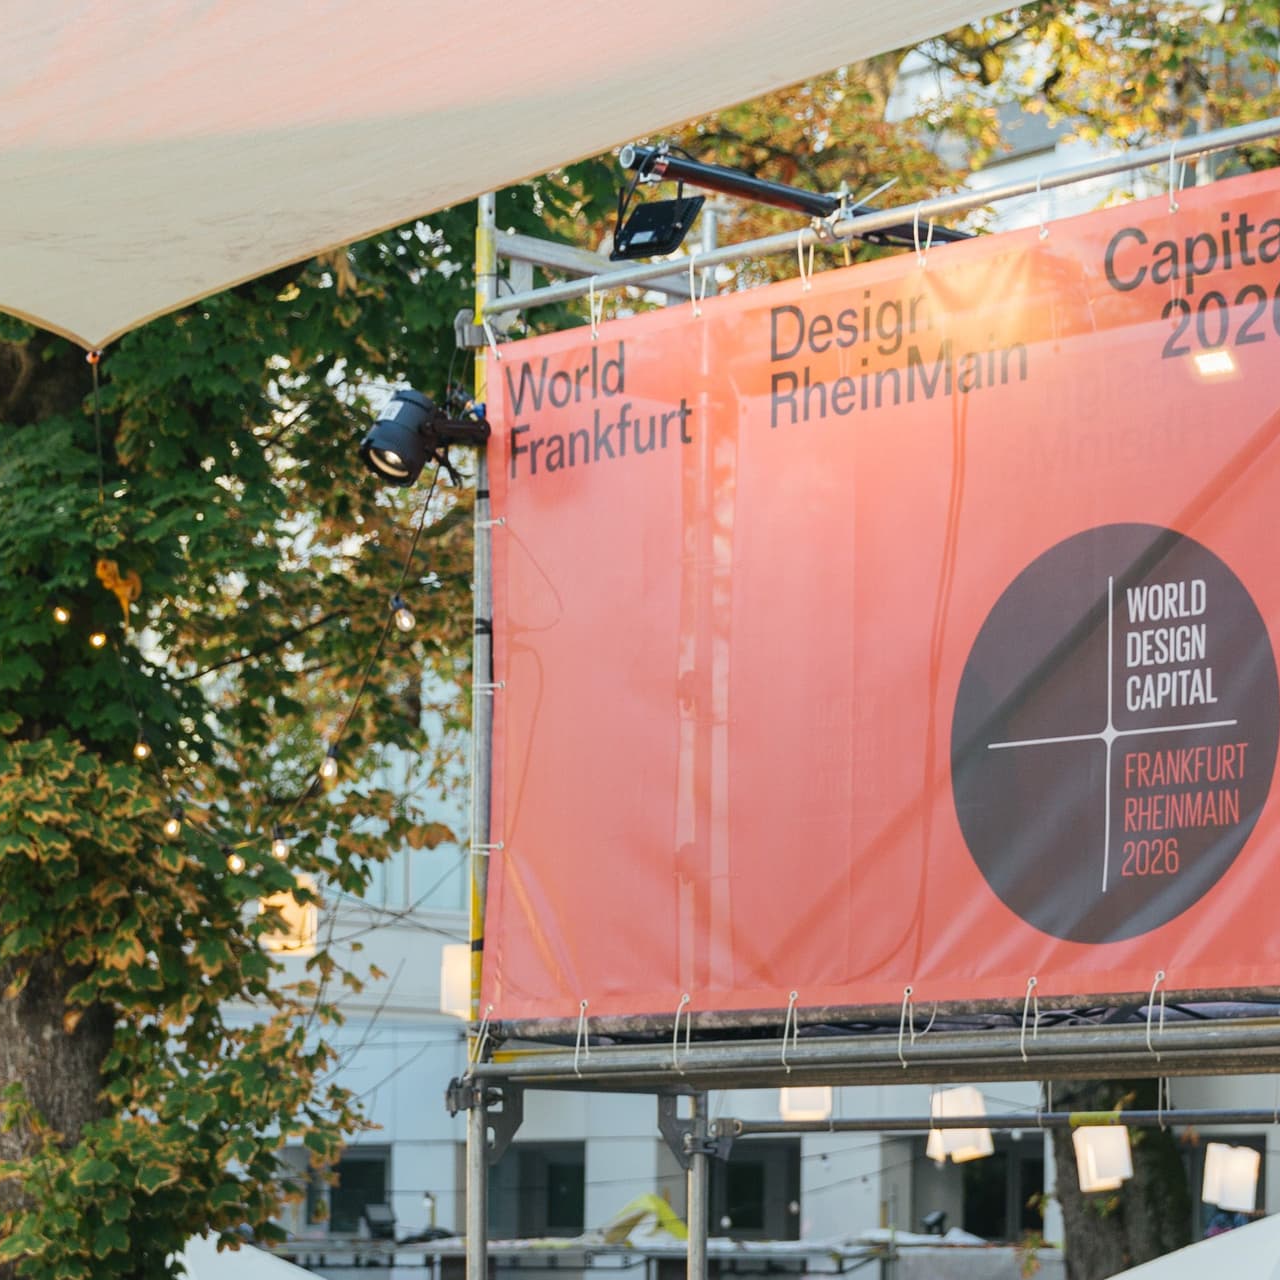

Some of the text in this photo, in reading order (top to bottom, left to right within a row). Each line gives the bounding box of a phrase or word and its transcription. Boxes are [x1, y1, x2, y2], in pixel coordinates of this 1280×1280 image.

[504, 342, 625, 416] World
[771, 339, 1028, 429] RheinMain
[509, 399, 693, 480] Frankfurt
[1127, 579, 1207, 623] WORLD
[1127, 624, 1206, 668] DESIGN
[1127, 667, 1218, 711] CAPITAL
[1124, 742, 1249, 789] FRANKFURT
[1124, 784, 1241, 833] RHEINMAIN
[1121, 838, 1181, 877] 2026
